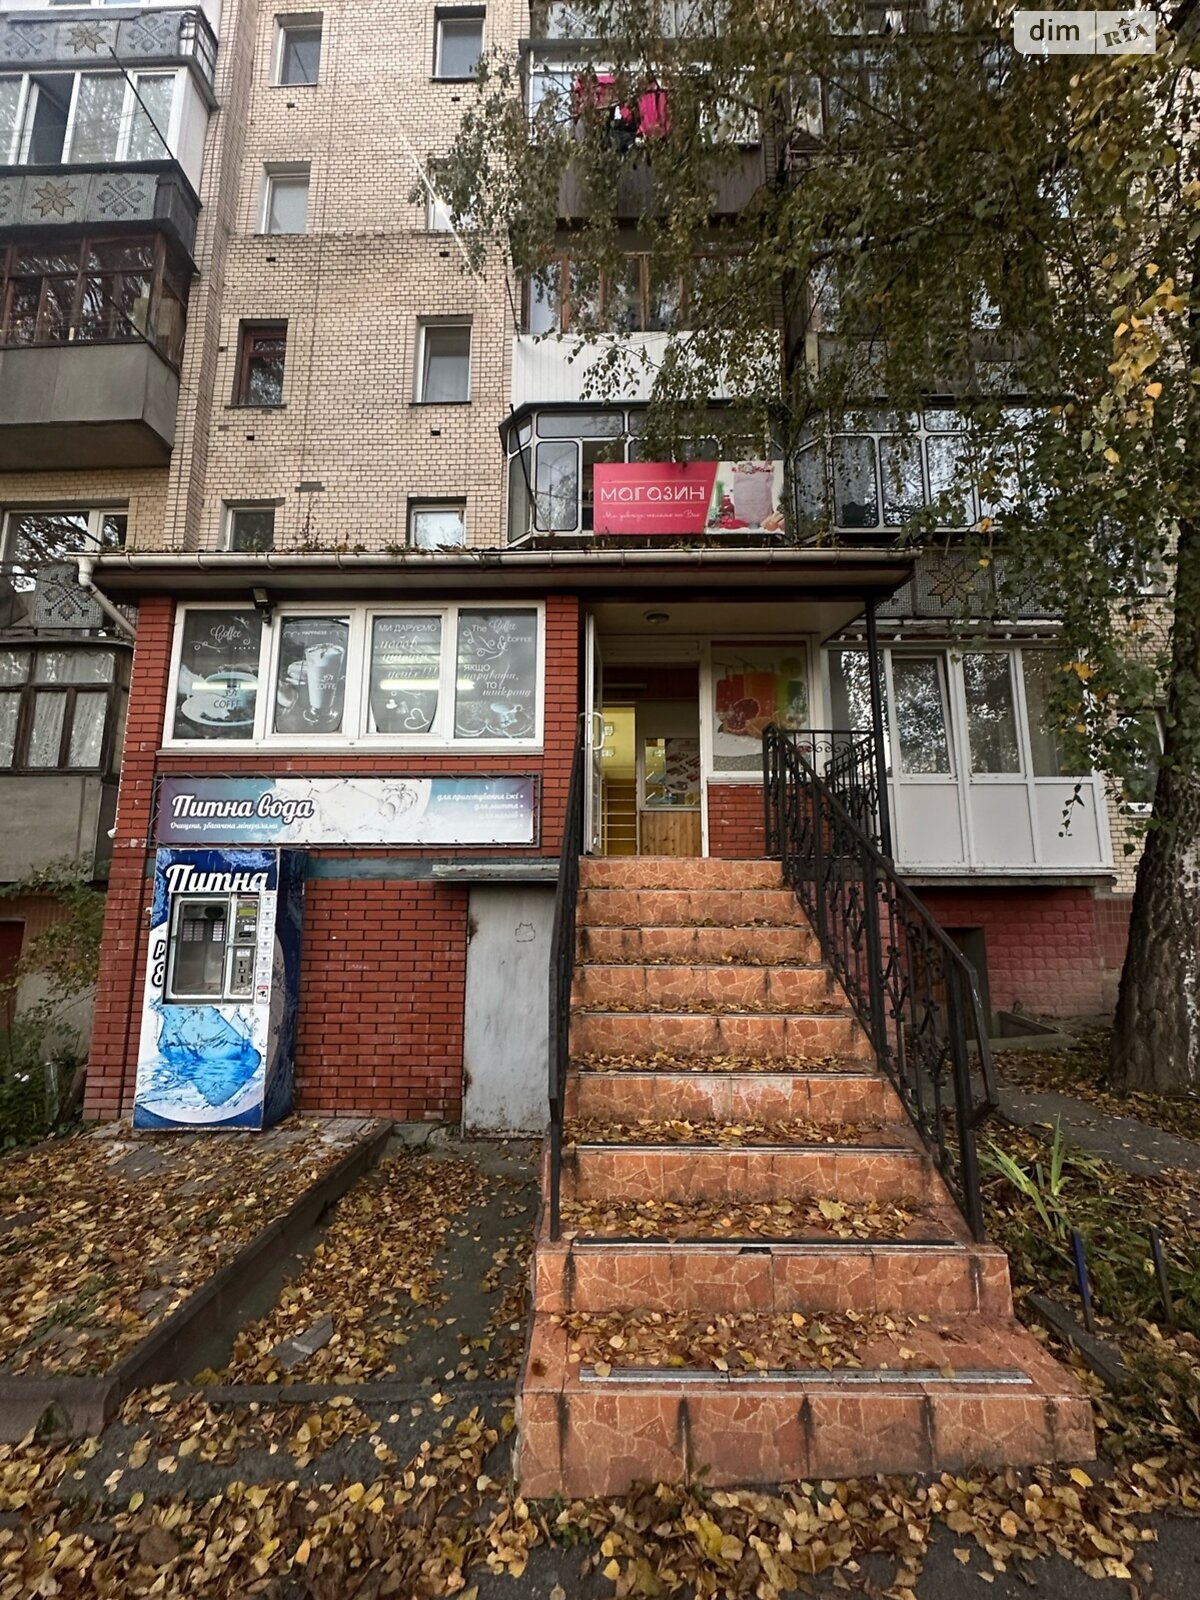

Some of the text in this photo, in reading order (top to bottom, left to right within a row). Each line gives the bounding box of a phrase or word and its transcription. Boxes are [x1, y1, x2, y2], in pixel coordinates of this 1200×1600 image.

[378, 623, 436, 633] МИ ДАРУЄМО
[470, 624, 487, 633] The
[210, 625, 241, 643] Coffee
[462, 664, 491, 673] ЯКЩО
[170, 793, 315, 824] Питна вода
[170, 821, 202, 831] Очищена,
[203, 821, 236, 831] збагачена
[165, 863, 269, 893] Питна
